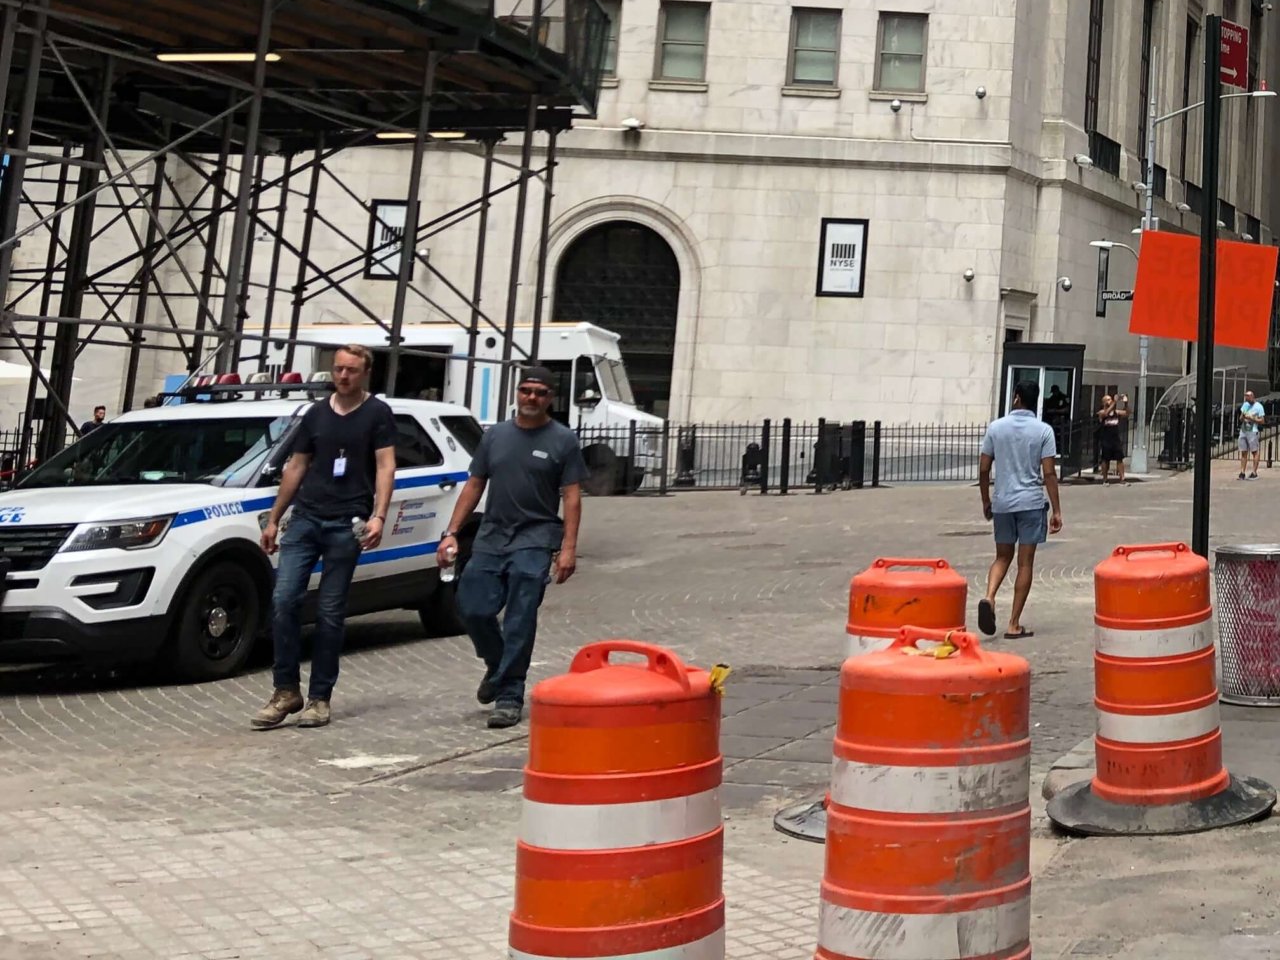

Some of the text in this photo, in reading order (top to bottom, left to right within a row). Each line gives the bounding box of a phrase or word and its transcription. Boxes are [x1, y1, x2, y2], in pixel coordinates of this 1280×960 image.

[1221, 26, 1242, 44] TOPPING
[830, 259, 855, 268] NYSE
[1103, 292, 1125, 300] BROAD
[204, 501, 243, 519] POLICE
[0, 513, 26, 523] CE
